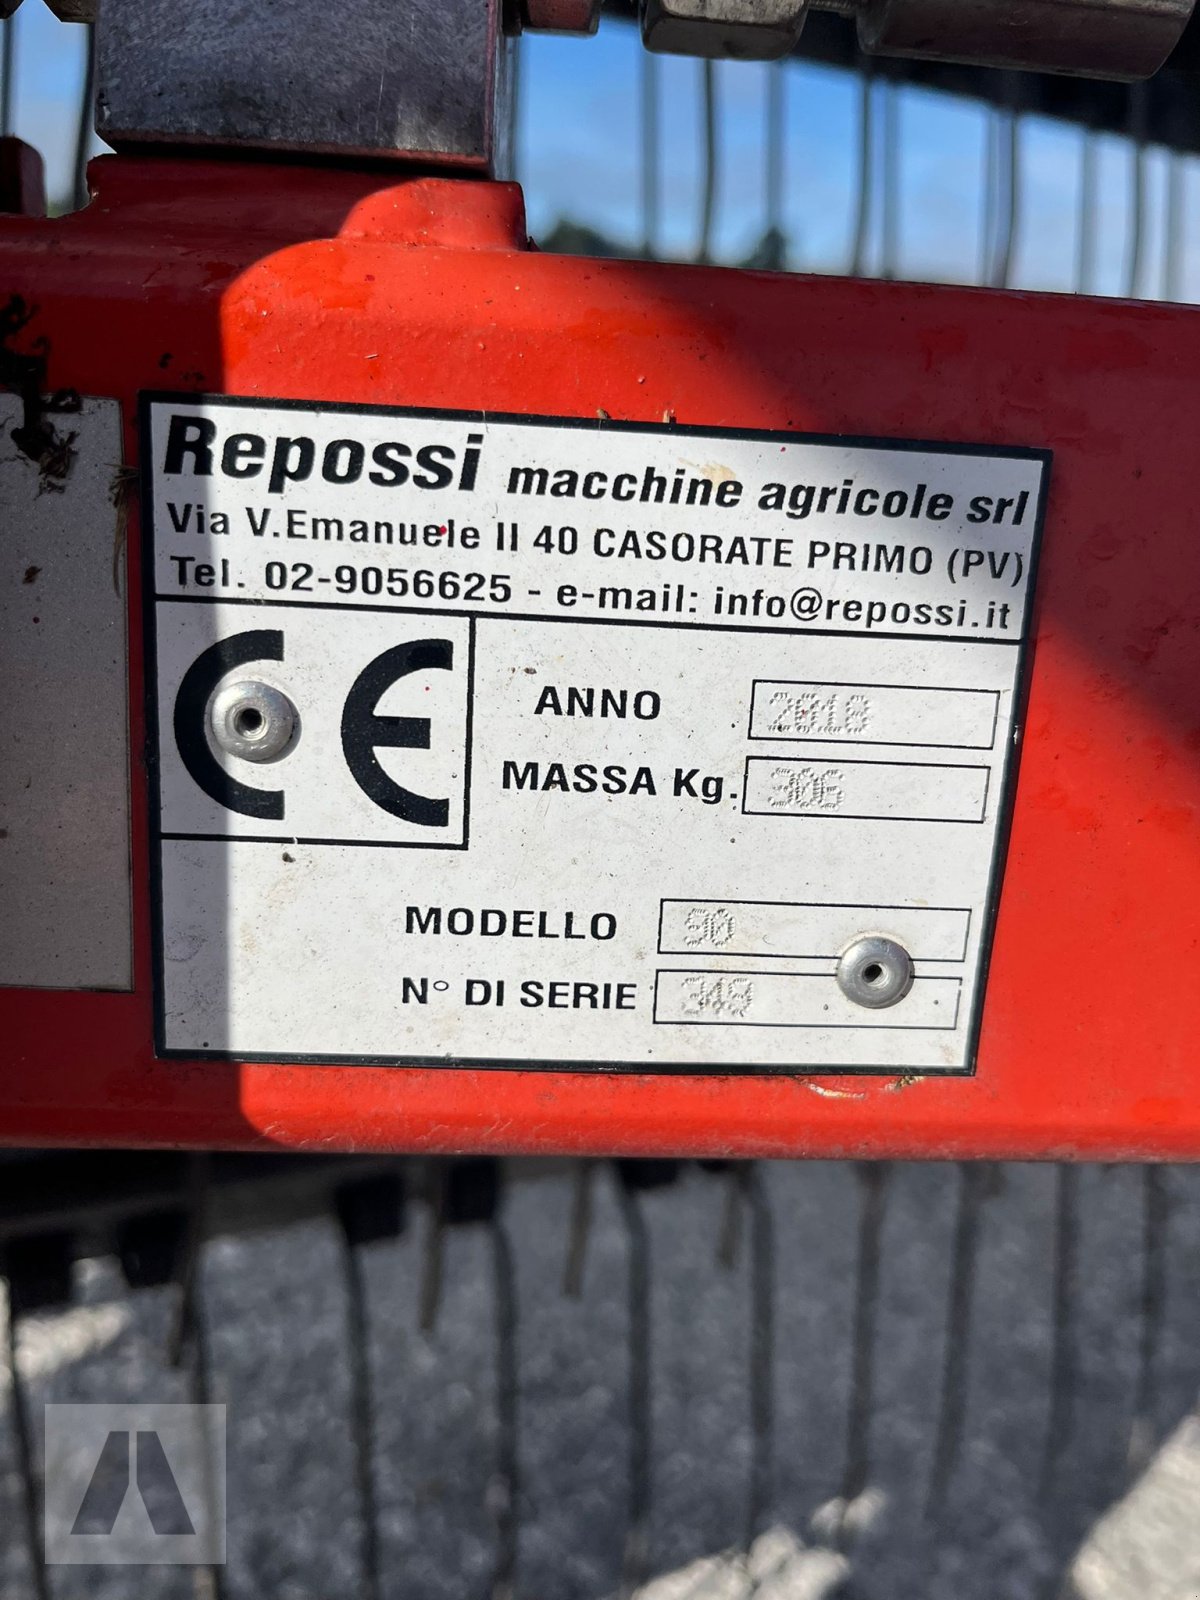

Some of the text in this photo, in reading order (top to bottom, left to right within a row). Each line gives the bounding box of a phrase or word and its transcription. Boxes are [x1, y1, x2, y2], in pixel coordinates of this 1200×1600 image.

[163, 415, 1029, 525] Repossi macchine agricole srl
[167, 503, 1023, 587] Via V.Emanuele II 40 CASORATE PRIMO (PV)
[170, 556, 245, 588] Tel.
[265, 561, 511, 603] 02-9056625
[557, 584, 698, 613] e-mail:
[715, 587, 1010, 629] info@repossi.it
[173, 629, 454, 827] CE
[534, 686, 872, 735] ANNO 2018
[502, 761, 656, 796] MASSA
[674, 769, 738, 804] Kg.
[405, 907, 617, 940] MODELLO
[465, 980, 504, 1006] DI
[520, 981, 637, 1010] SERIE
